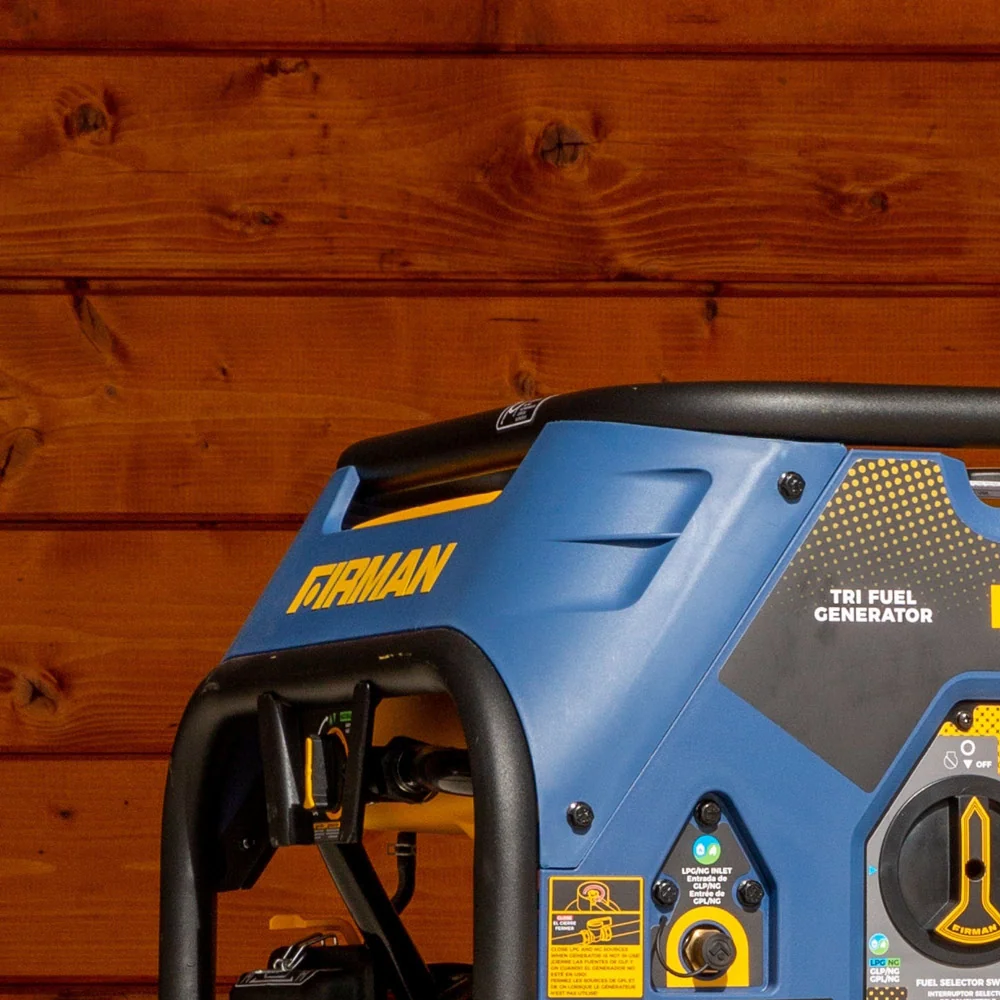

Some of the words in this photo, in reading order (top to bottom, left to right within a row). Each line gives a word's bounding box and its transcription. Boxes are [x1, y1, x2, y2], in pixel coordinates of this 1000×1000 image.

[286, 542, 458, 614] FIRMAN
[830, 589, 861, 604] TRI
[868, 589, 917, 605] FUEL
[814, 607, 933, 623] GENERATOR
[976, 760, 992, 768] OFF
[682, 867, 709, 875] LPG/NG
[693, 882, 721, 890] GLP/NG
[952, 923, 997, 935] FIRMAN
[870, 975, 900, 983] GPL/NG
[916, 979, 938, 987] FUEL
[940, 979, 984, 987] SELECTOR
